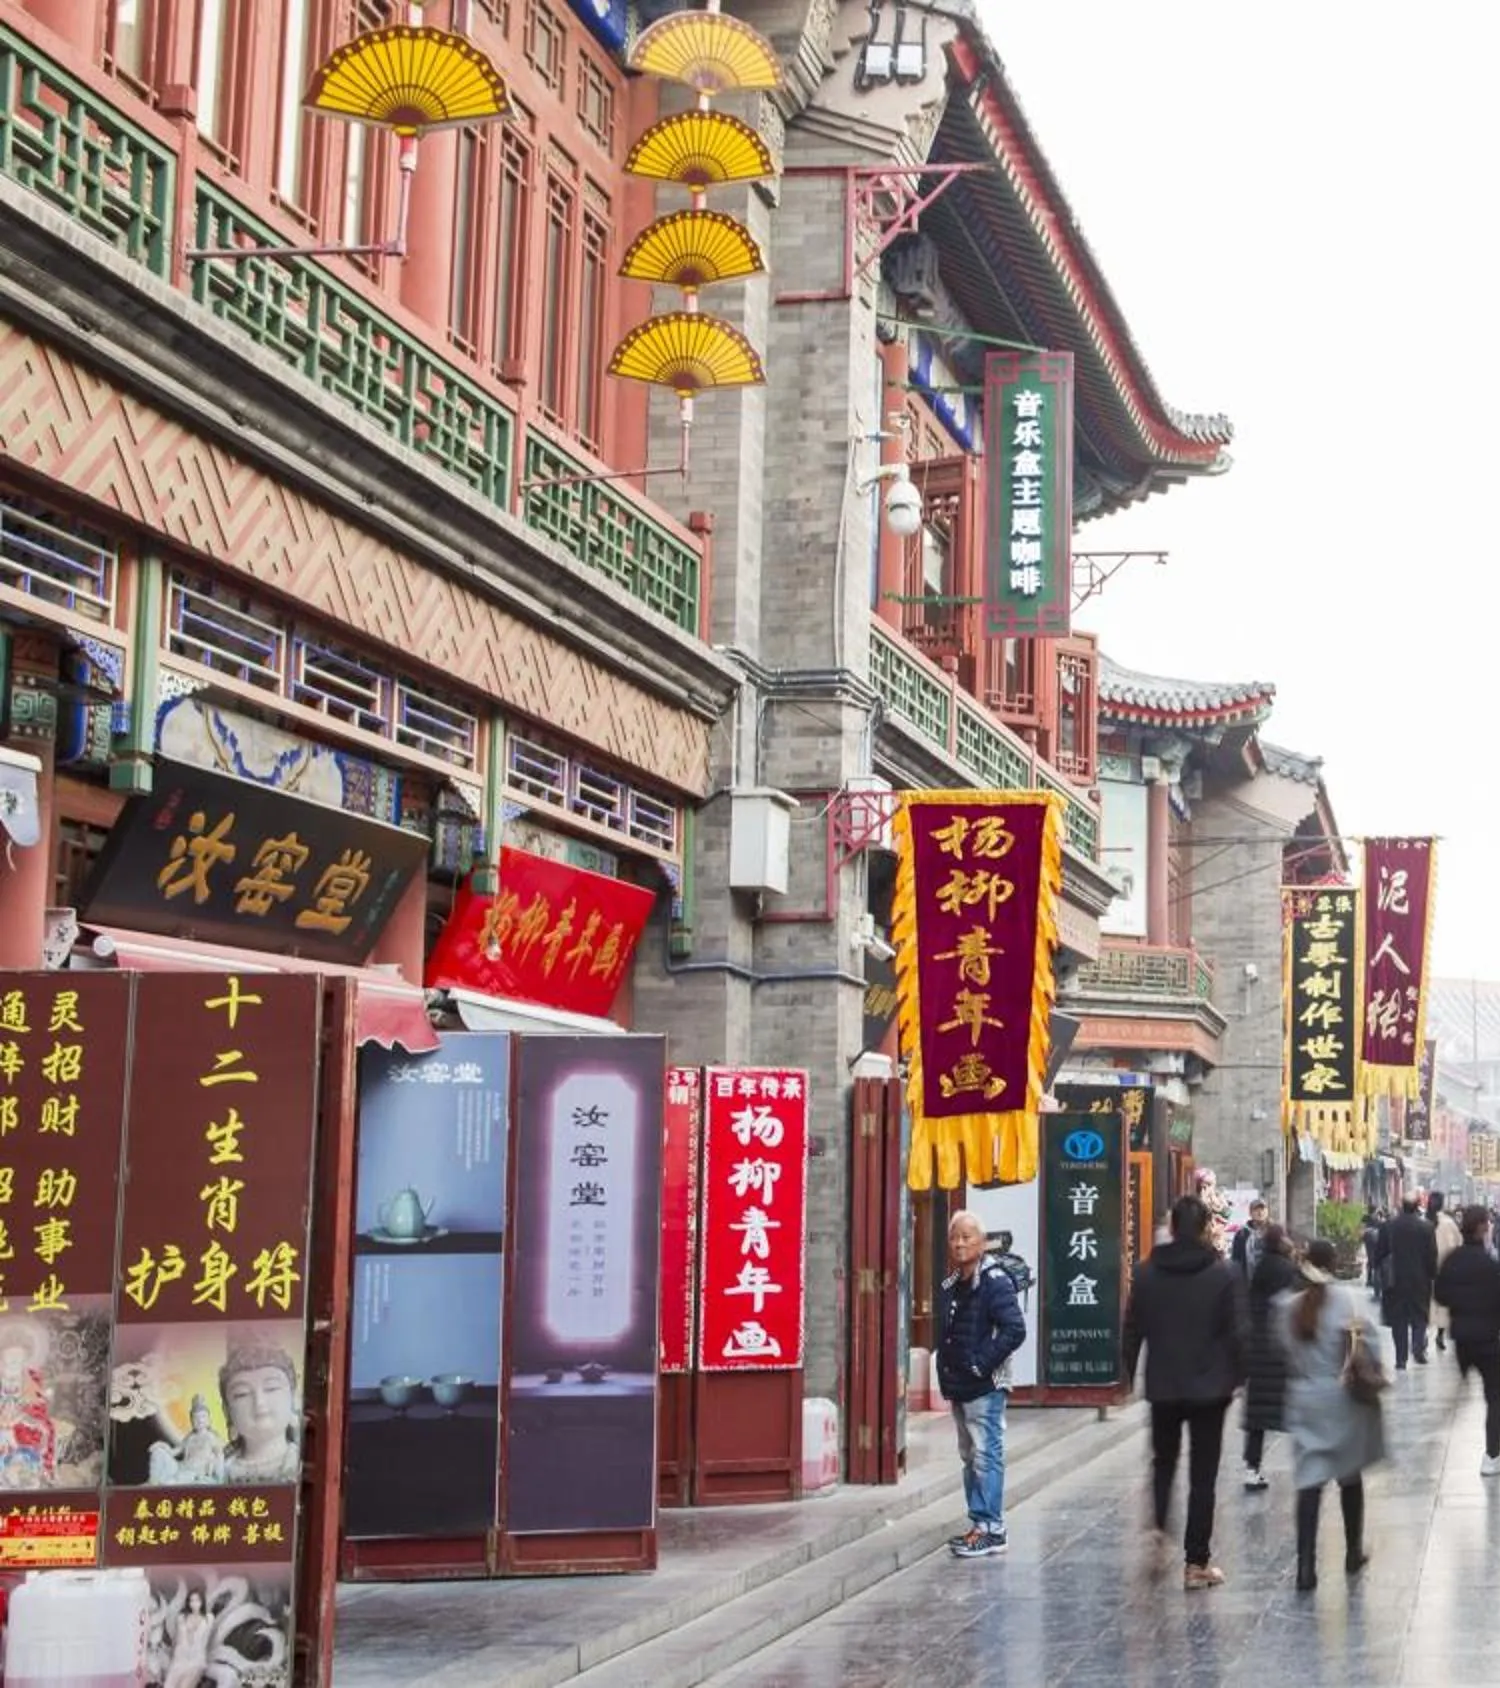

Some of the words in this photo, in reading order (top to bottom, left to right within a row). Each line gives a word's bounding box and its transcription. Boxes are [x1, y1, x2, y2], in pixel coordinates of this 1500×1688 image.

[1010, 389, 1043, 595] 音乐盒主题咖啡
[157, 810, 372, 935] 汝窑堂
[930, 814, 1015, 1101] 杨柳青年画
[1298, 914, 1349, 1094] 古琴制作世家
[200, 976, 263, 1232] 十二生肖
[569, 1105, 609, 1208] 汝窑堂
[717, 1076, 802, 1100] 百年传承
[125, 1241, 300, 1313] 护身符
[722, 1104, 785, 1358] 杨柳青年画
[1066, 1182, 1099, 1306] 音乐盒
